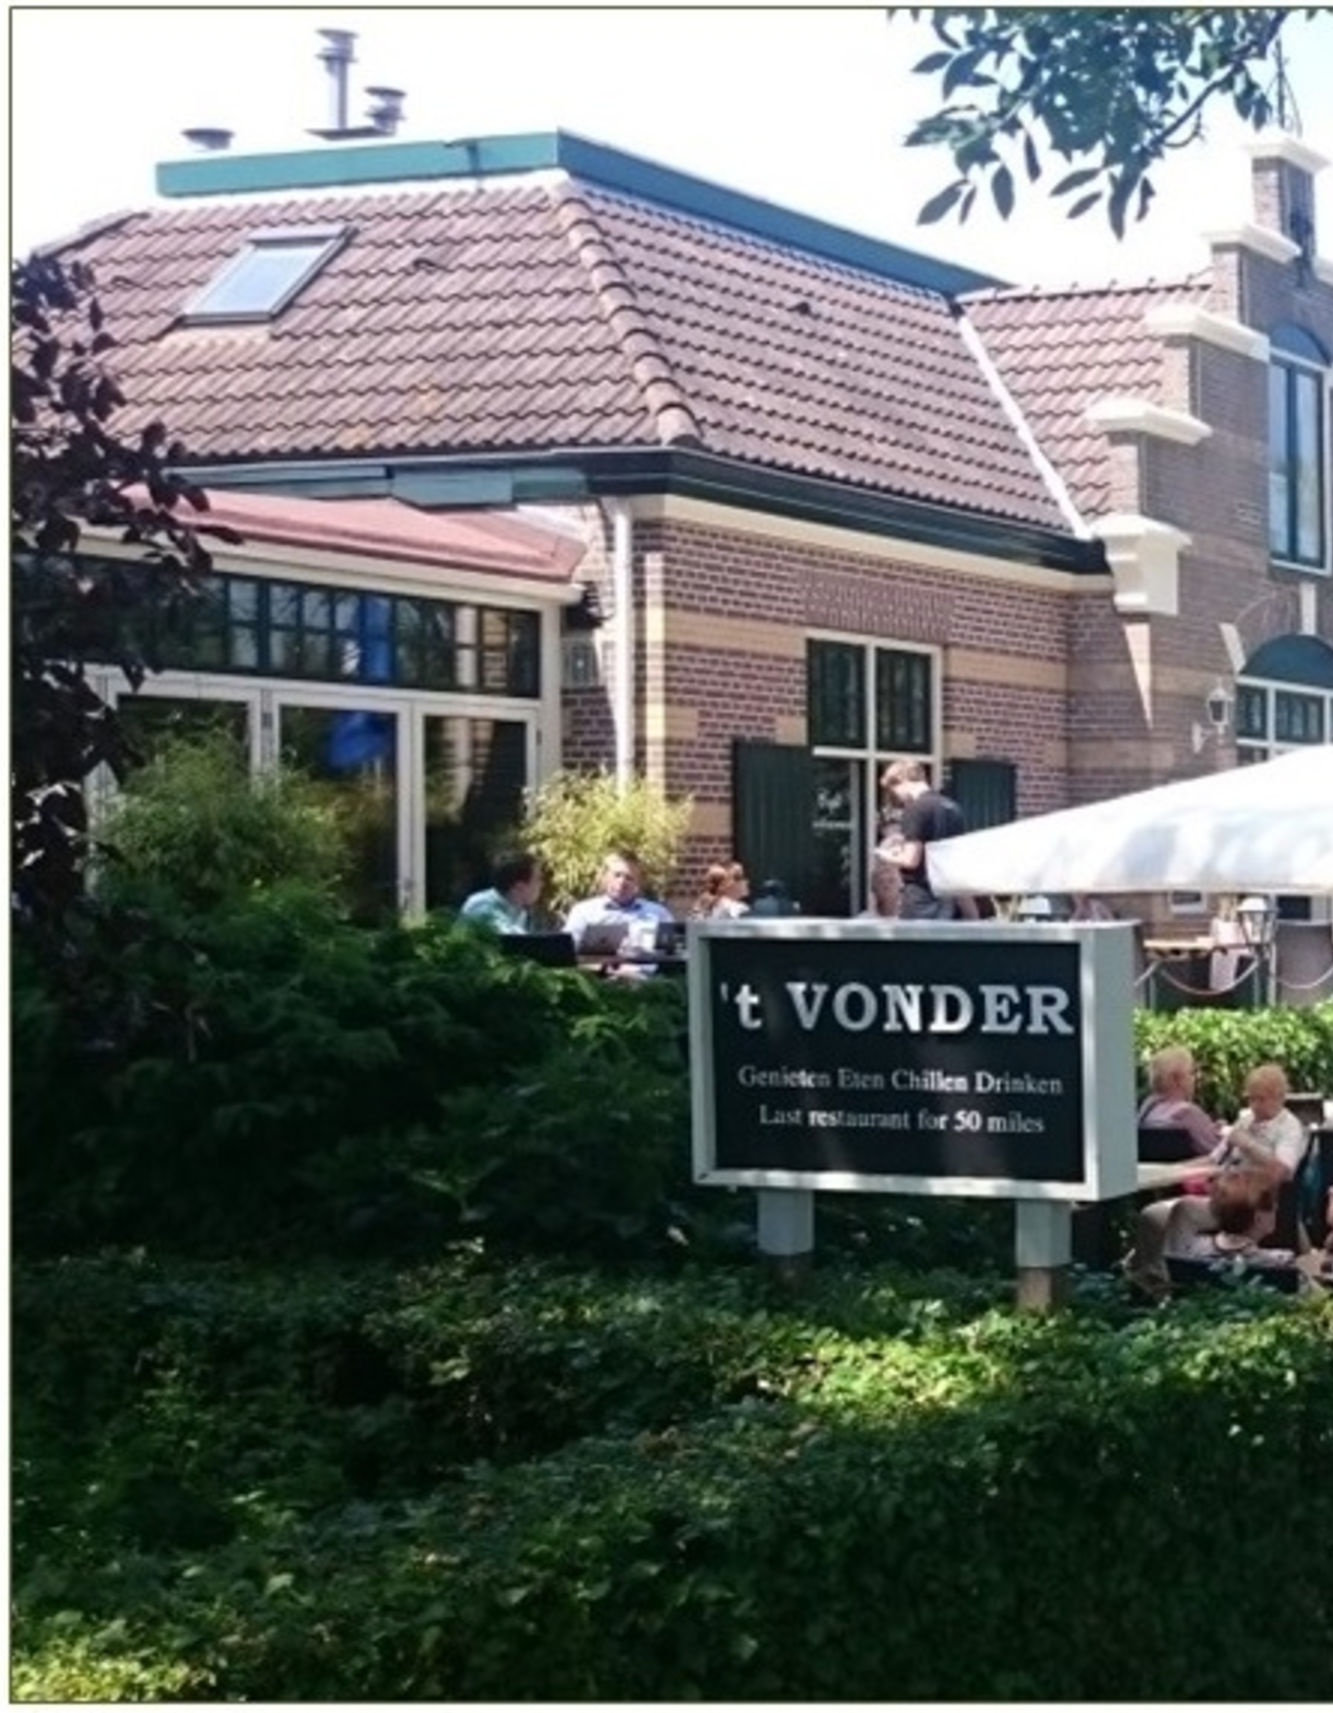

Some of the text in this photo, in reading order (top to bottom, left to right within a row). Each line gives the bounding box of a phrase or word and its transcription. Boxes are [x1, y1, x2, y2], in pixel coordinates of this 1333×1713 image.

[785, 981, 1075, 1034] VONDER
[738, 1064, 1063, 1095] Genieten Eten Chillen Drinken
[759, 1105, 1045, 1134] Last restaurant for 50 miles
